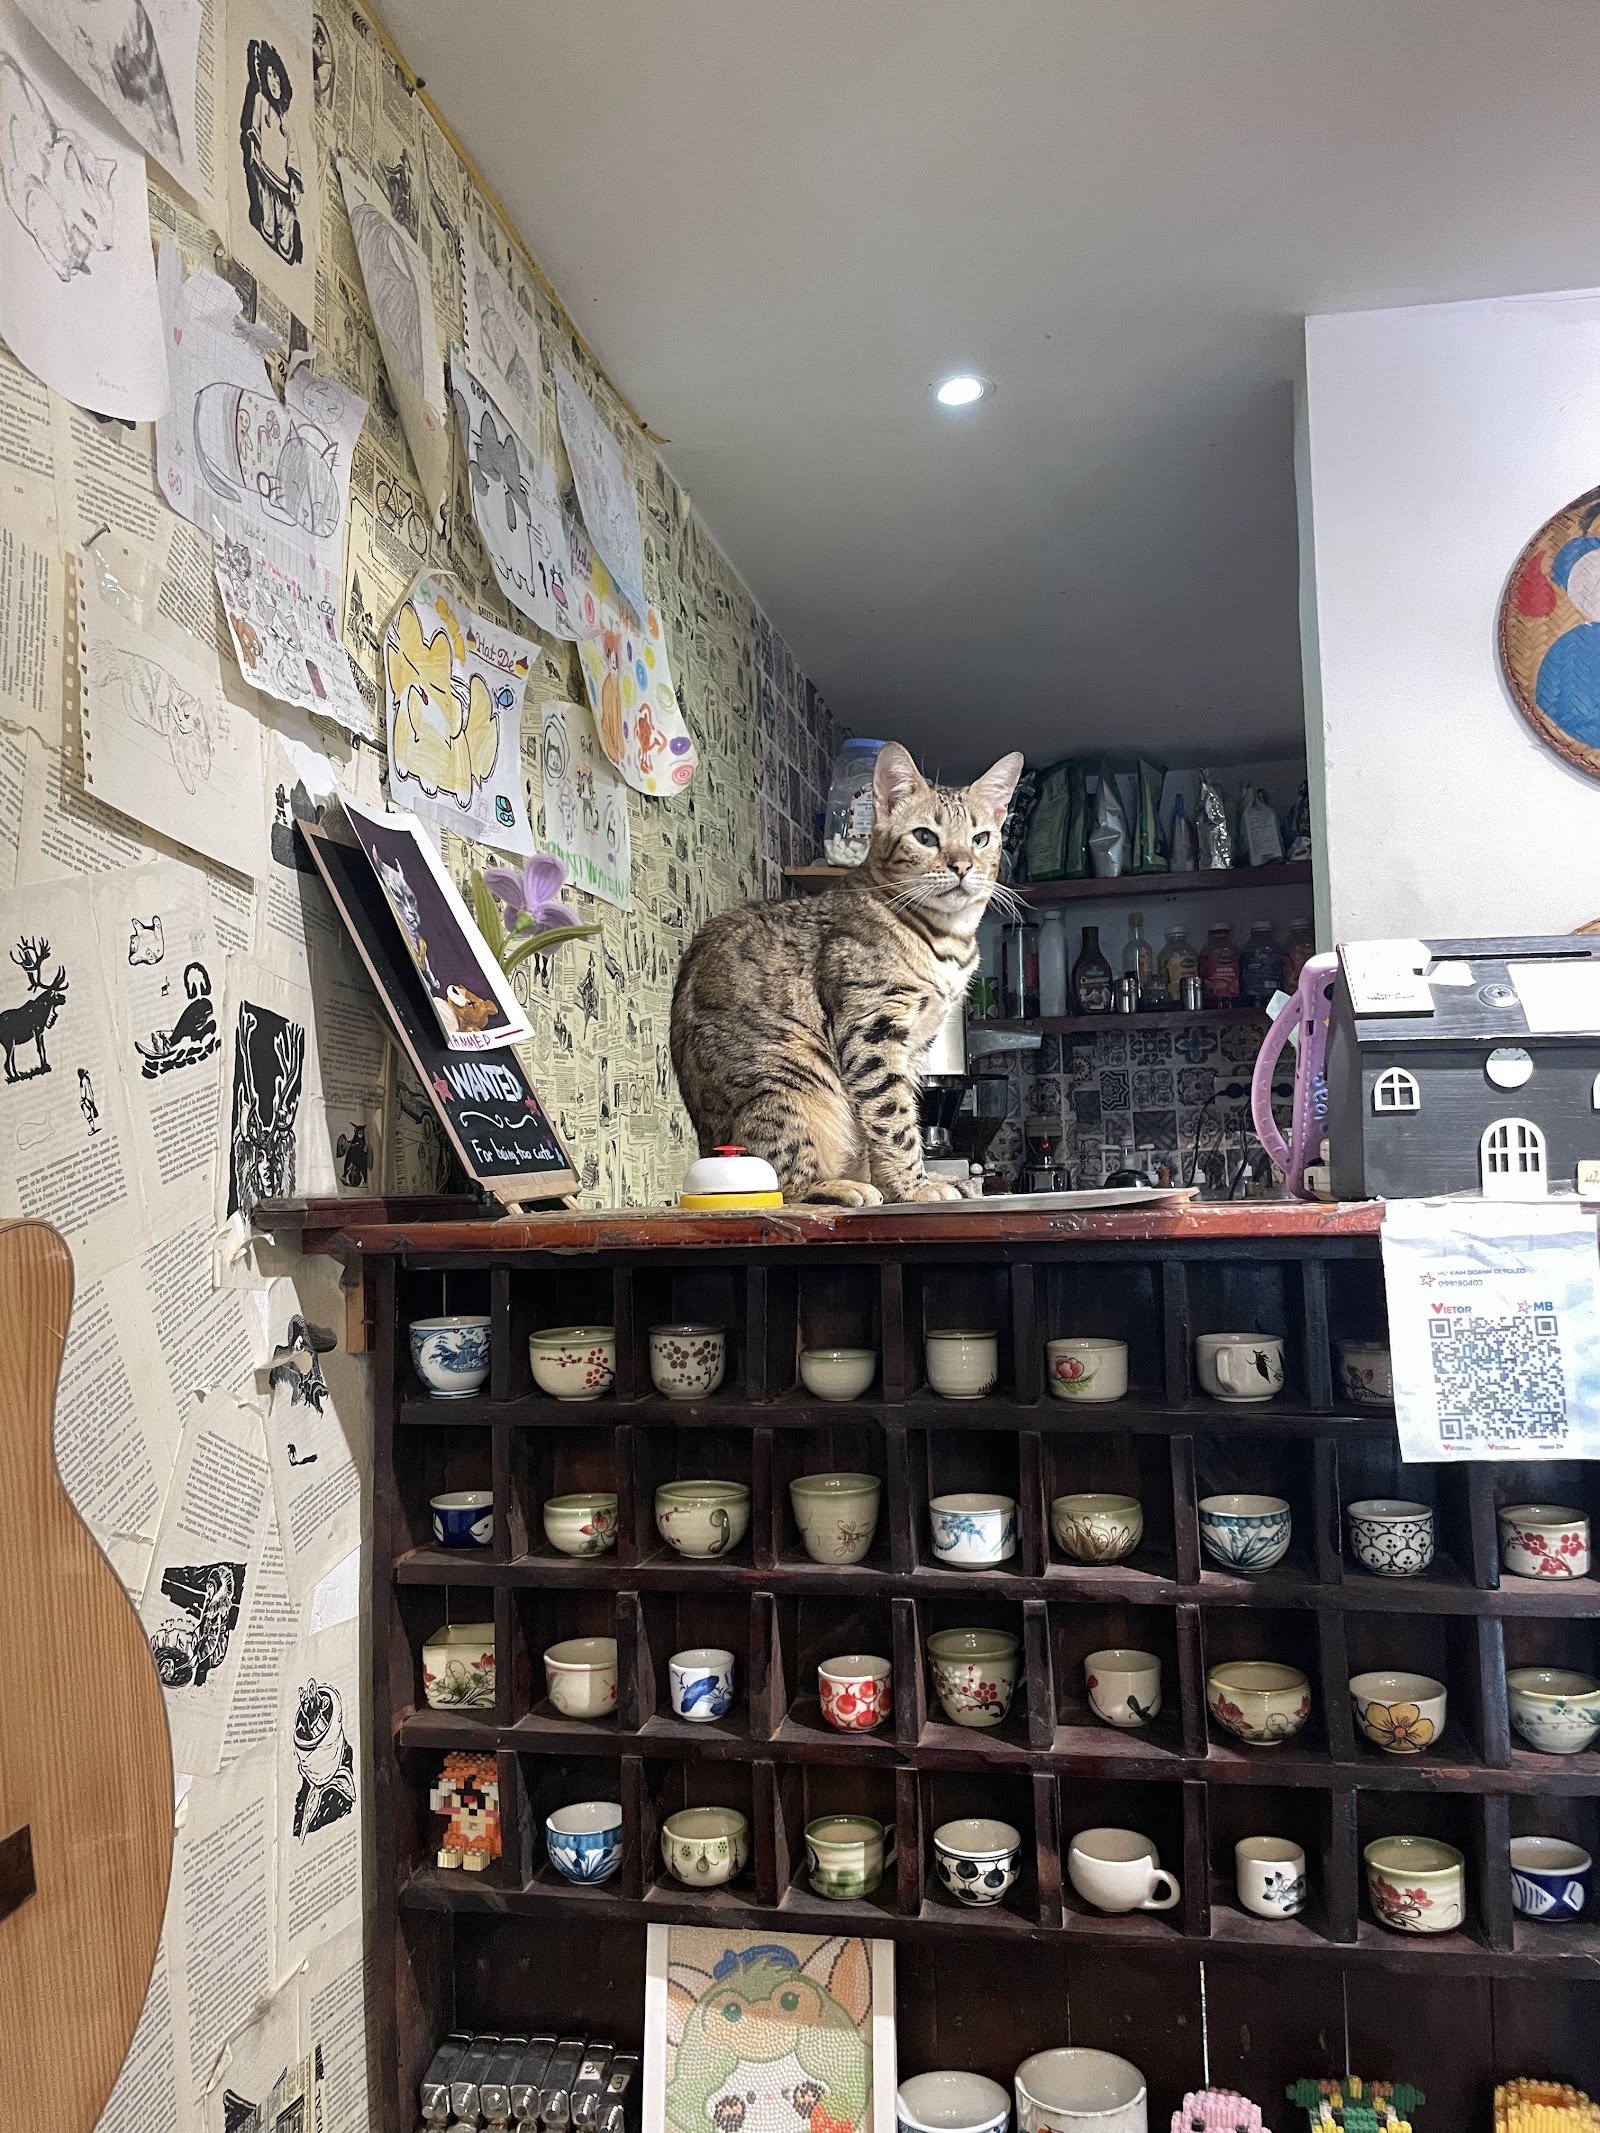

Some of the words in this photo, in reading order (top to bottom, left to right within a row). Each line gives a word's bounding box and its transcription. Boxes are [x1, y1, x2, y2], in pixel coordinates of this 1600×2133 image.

[443, 1062, 523, 1102] WANTED
[471, 1138, 493, 1164] For
[1533, 1301, 1554, 1312] MB
[584, 2064, 594, 2075] 2
[612, 2075, 624, 2090] 3
